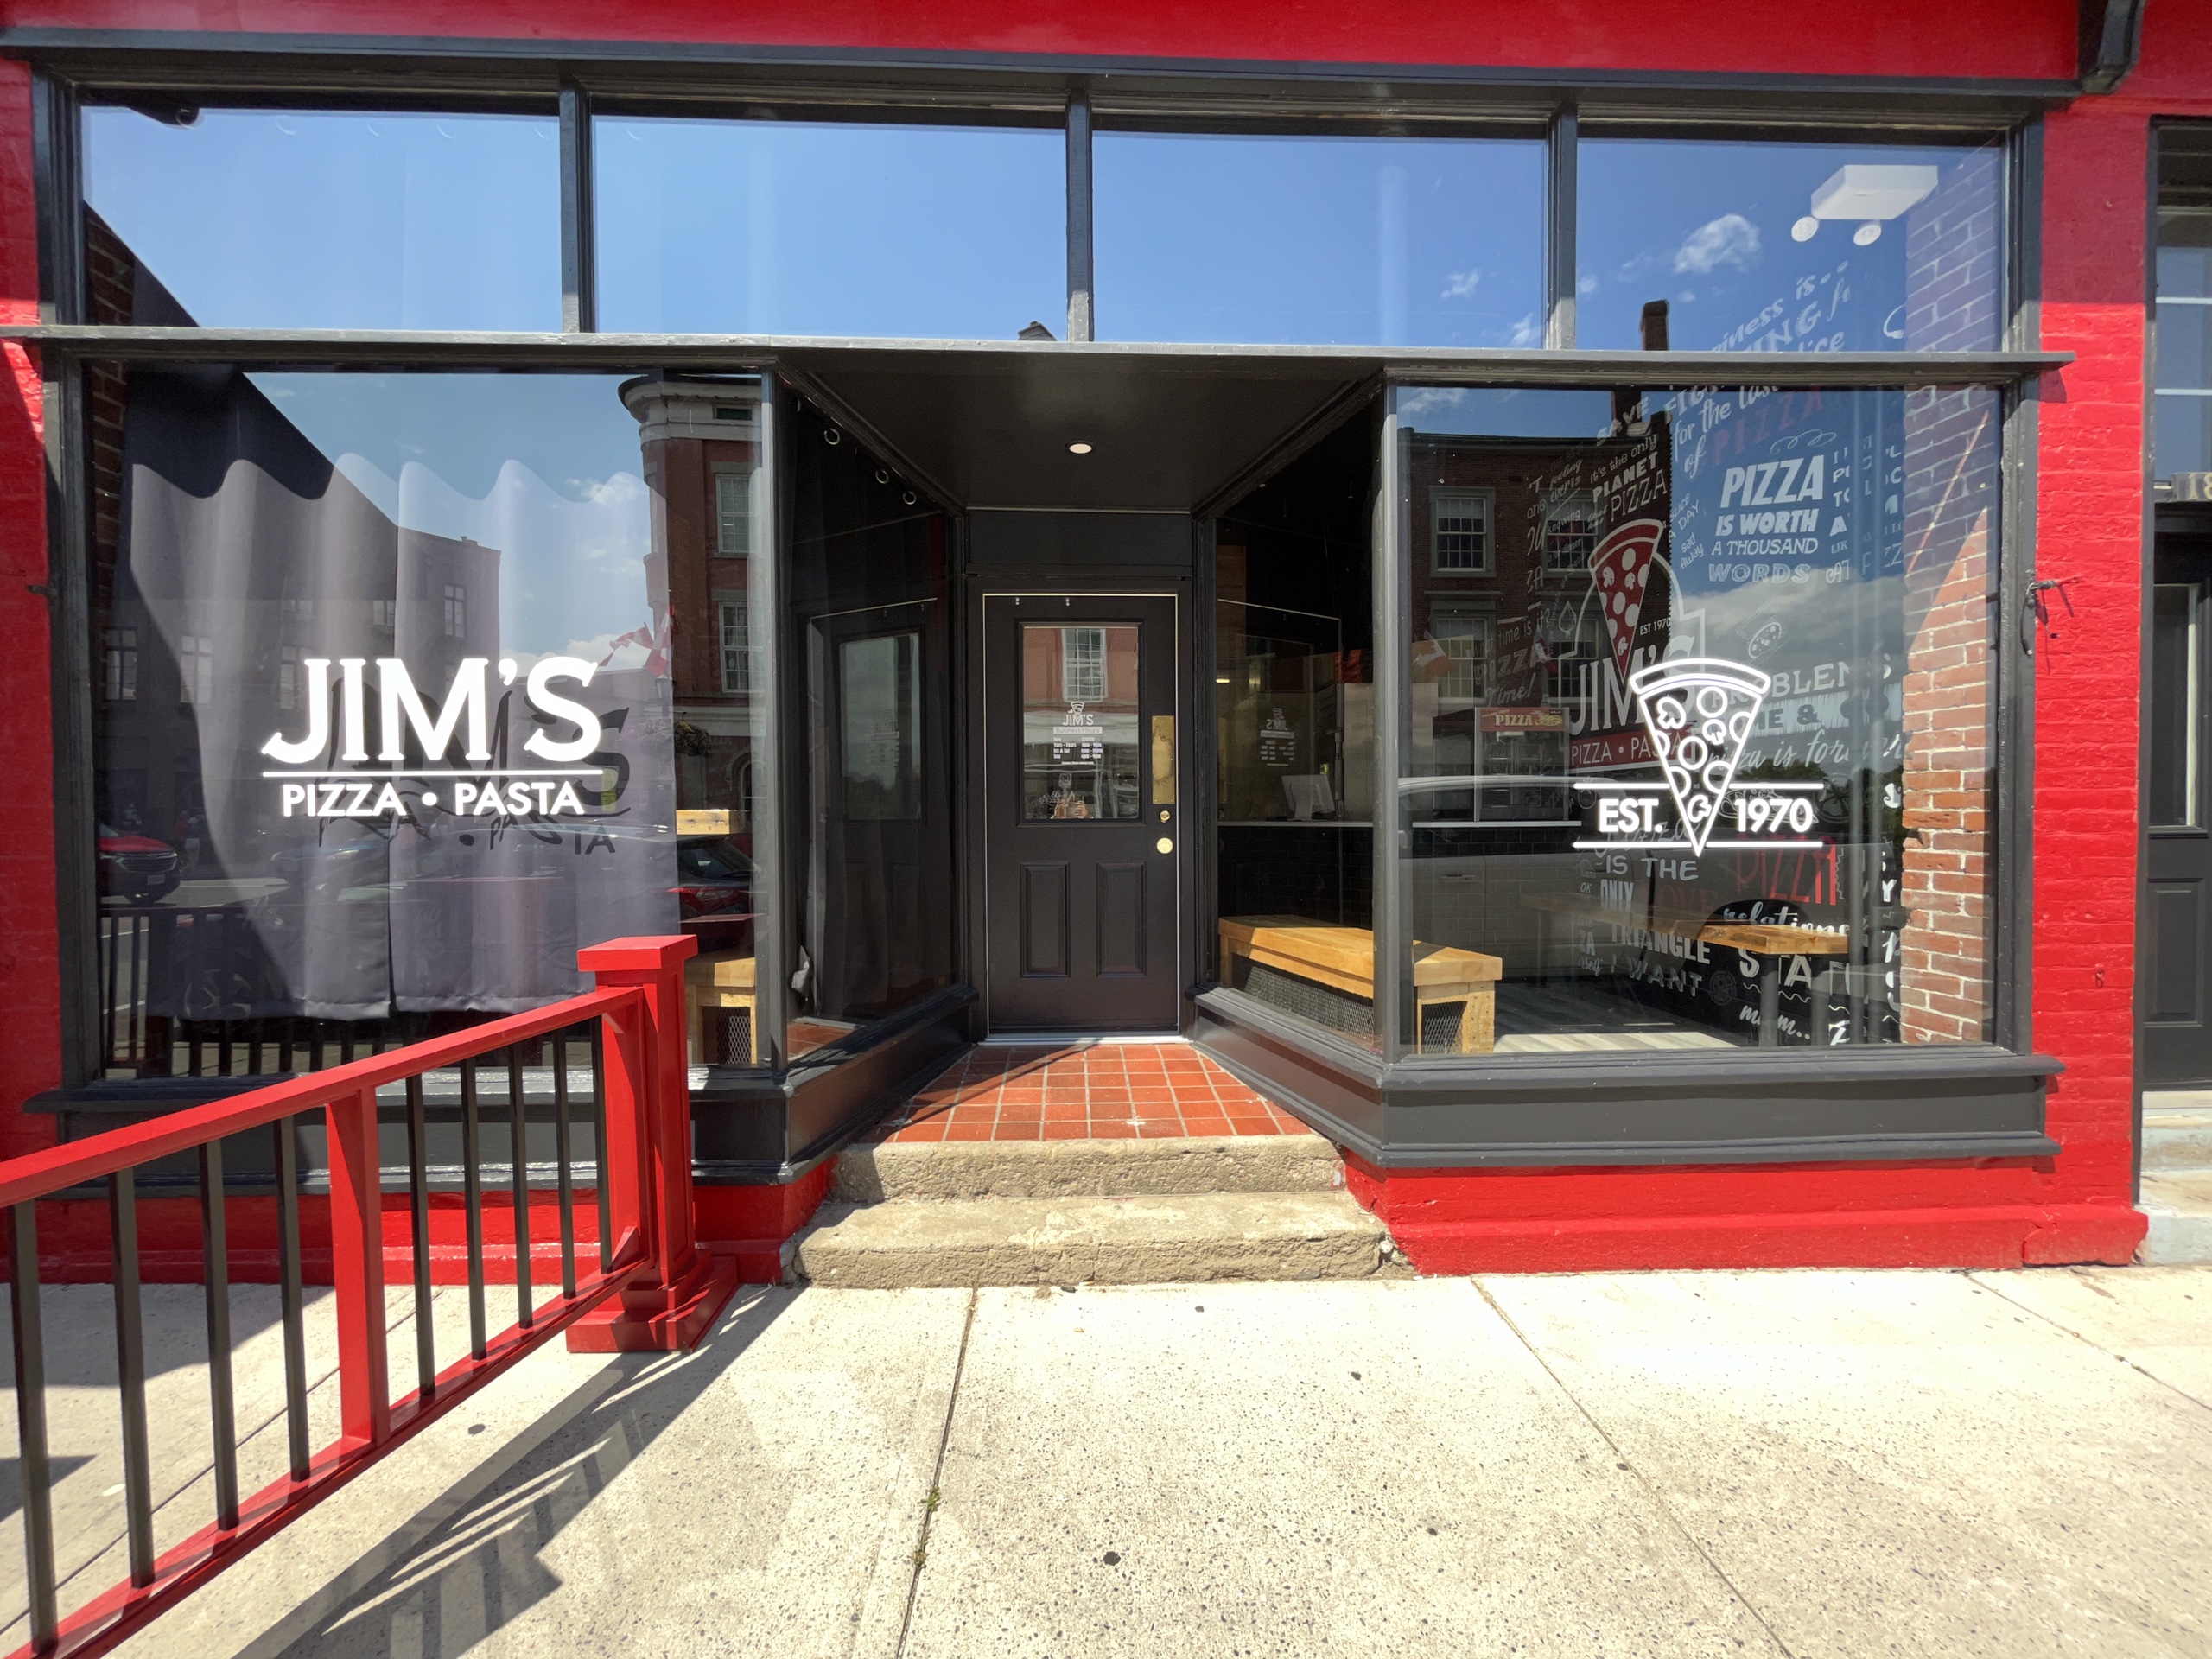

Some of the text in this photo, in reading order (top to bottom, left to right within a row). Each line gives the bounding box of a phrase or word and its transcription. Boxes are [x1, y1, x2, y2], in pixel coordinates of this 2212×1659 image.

[1672, 418, 1694, 462] for
[1698, 398, 1732, 433] the
[1609, 454, 1628, 471] the
[1631, 433, 1658, 458] only
[1684, 434, 1707, 480] of
[1592, 451, 1658, 503] PLANET
[1610, 468, 1668, 523] PIZZA
[1719, 454, 1824, 508] PIZZA
[1714, 514, 1734, 537] IS
[1739, 508, 1819, 536] WORTH
[1711, 537, 1819, 556] A THOUSAND
[1708, 562, 1812, 584] WORDS
[1497, 627, 1520, 649] time
[1523, 620, 1533, 638] is
[1639, 616, 1671, 636] EST 1970
[261, 656, 602, 764] JIM'S
[1062, 714, 1094, 726] JIM'S
[1495, 715, 1534, 727] PIZZA
[1572, 729, 1682, 766] PIZZA PAA
[1773, 740, 1797, 768] is
[283, 781, 406, 817] PIZZA
[454, 779, 585, 817] PASTA
[1599, 798, 1814, 834] EST. 1970
[1606, 854, 1700, 881] IS THE
[1737, 833, 1837, 906] PIZZA
[1611, 922, 1711, 965] TRIANGLE
[1629, 955, 1703, 997] WANT
